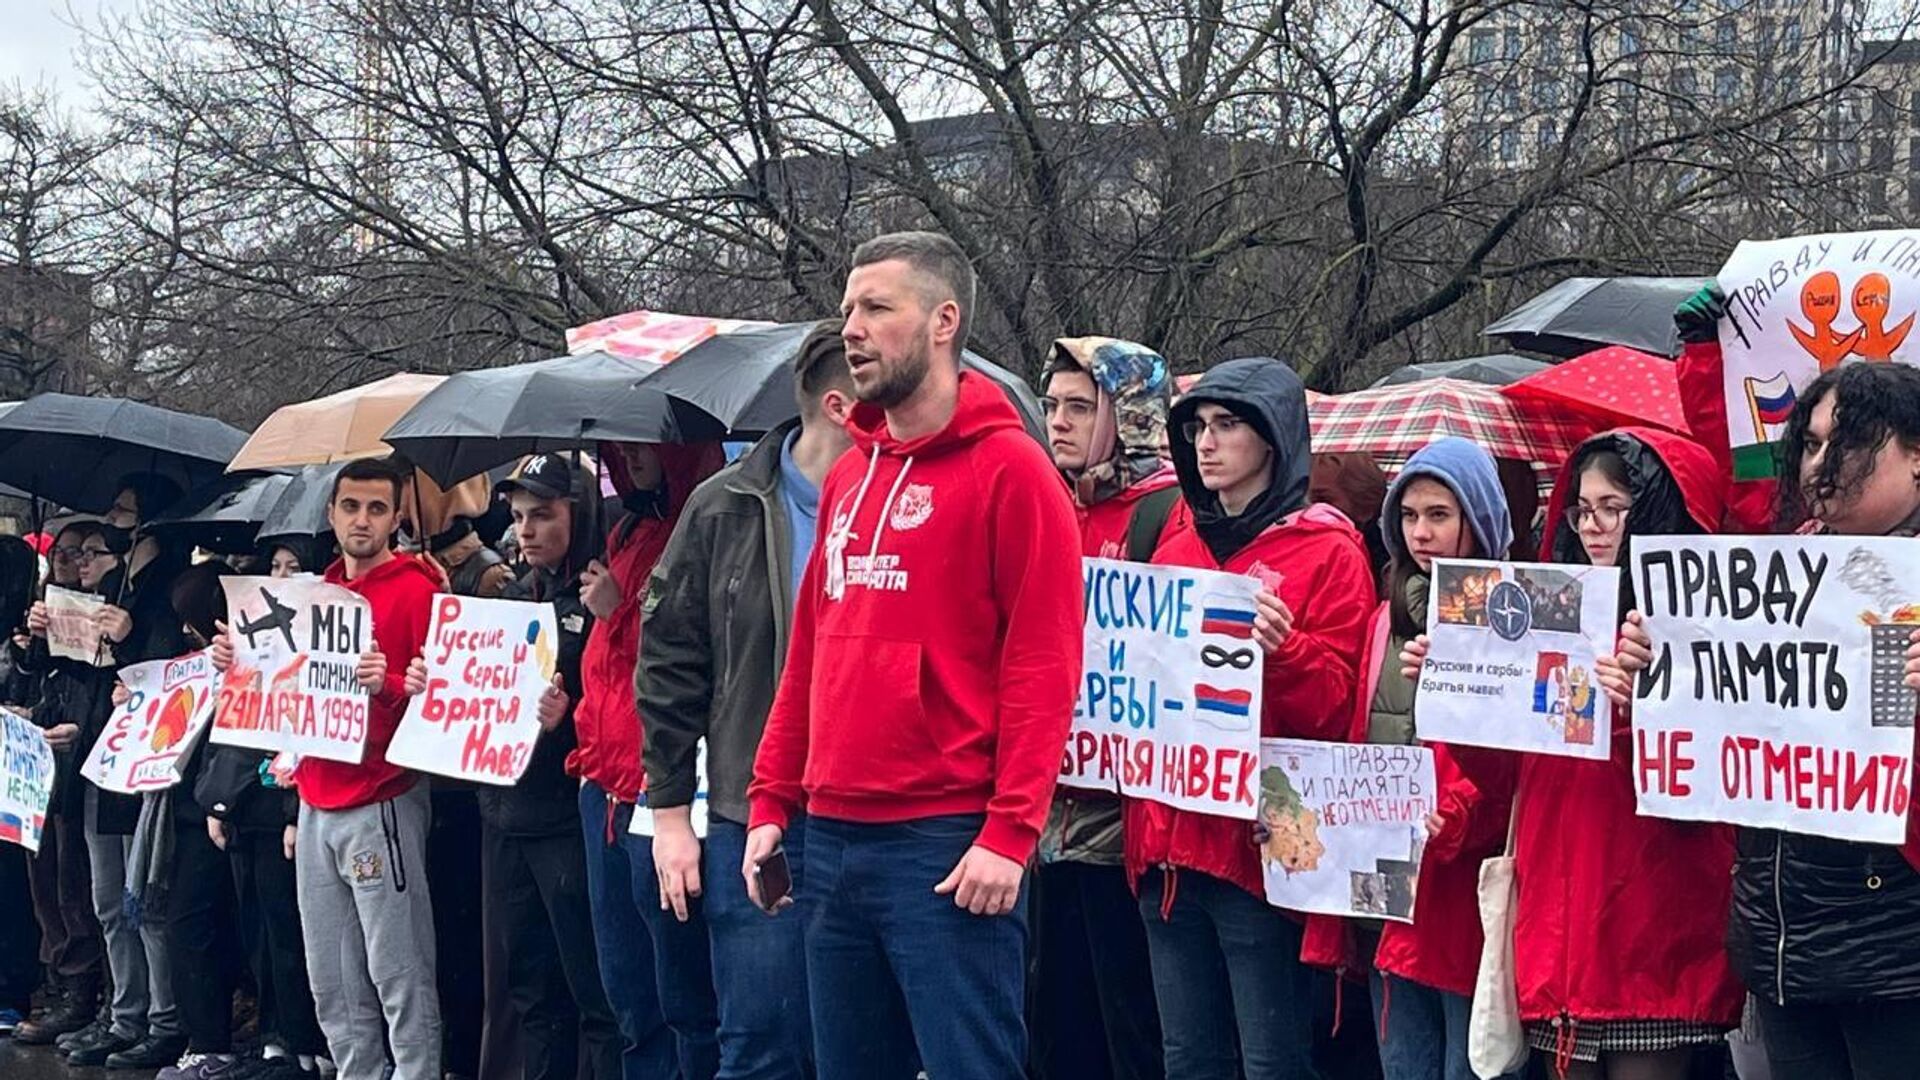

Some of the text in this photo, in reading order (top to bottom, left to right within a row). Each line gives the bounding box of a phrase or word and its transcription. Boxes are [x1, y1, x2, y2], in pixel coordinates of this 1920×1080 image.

[1724, 236, 1920, 350] ПРАВДУ И ПА
[1640, 547, 1829, 628] ПРАВДУ
[310, 604, 362, 654] МЫ
[434, 597, 527, 665] Русские и
[1109, 639, 1125, 671] И
[1636, 640, 1849, 712] И ПАМЯТЬ
[322, 697, 365, 743] 1999
[1161, 743, 1257, 807] НАВЕК
[1302, 775, 1421, 799] И ПАМЯТЬ
[1331, 745, 1423, 775] ПРАВДУ
[1638, 728, 1910, 817] НЕ ОТМЕНИТЬ
